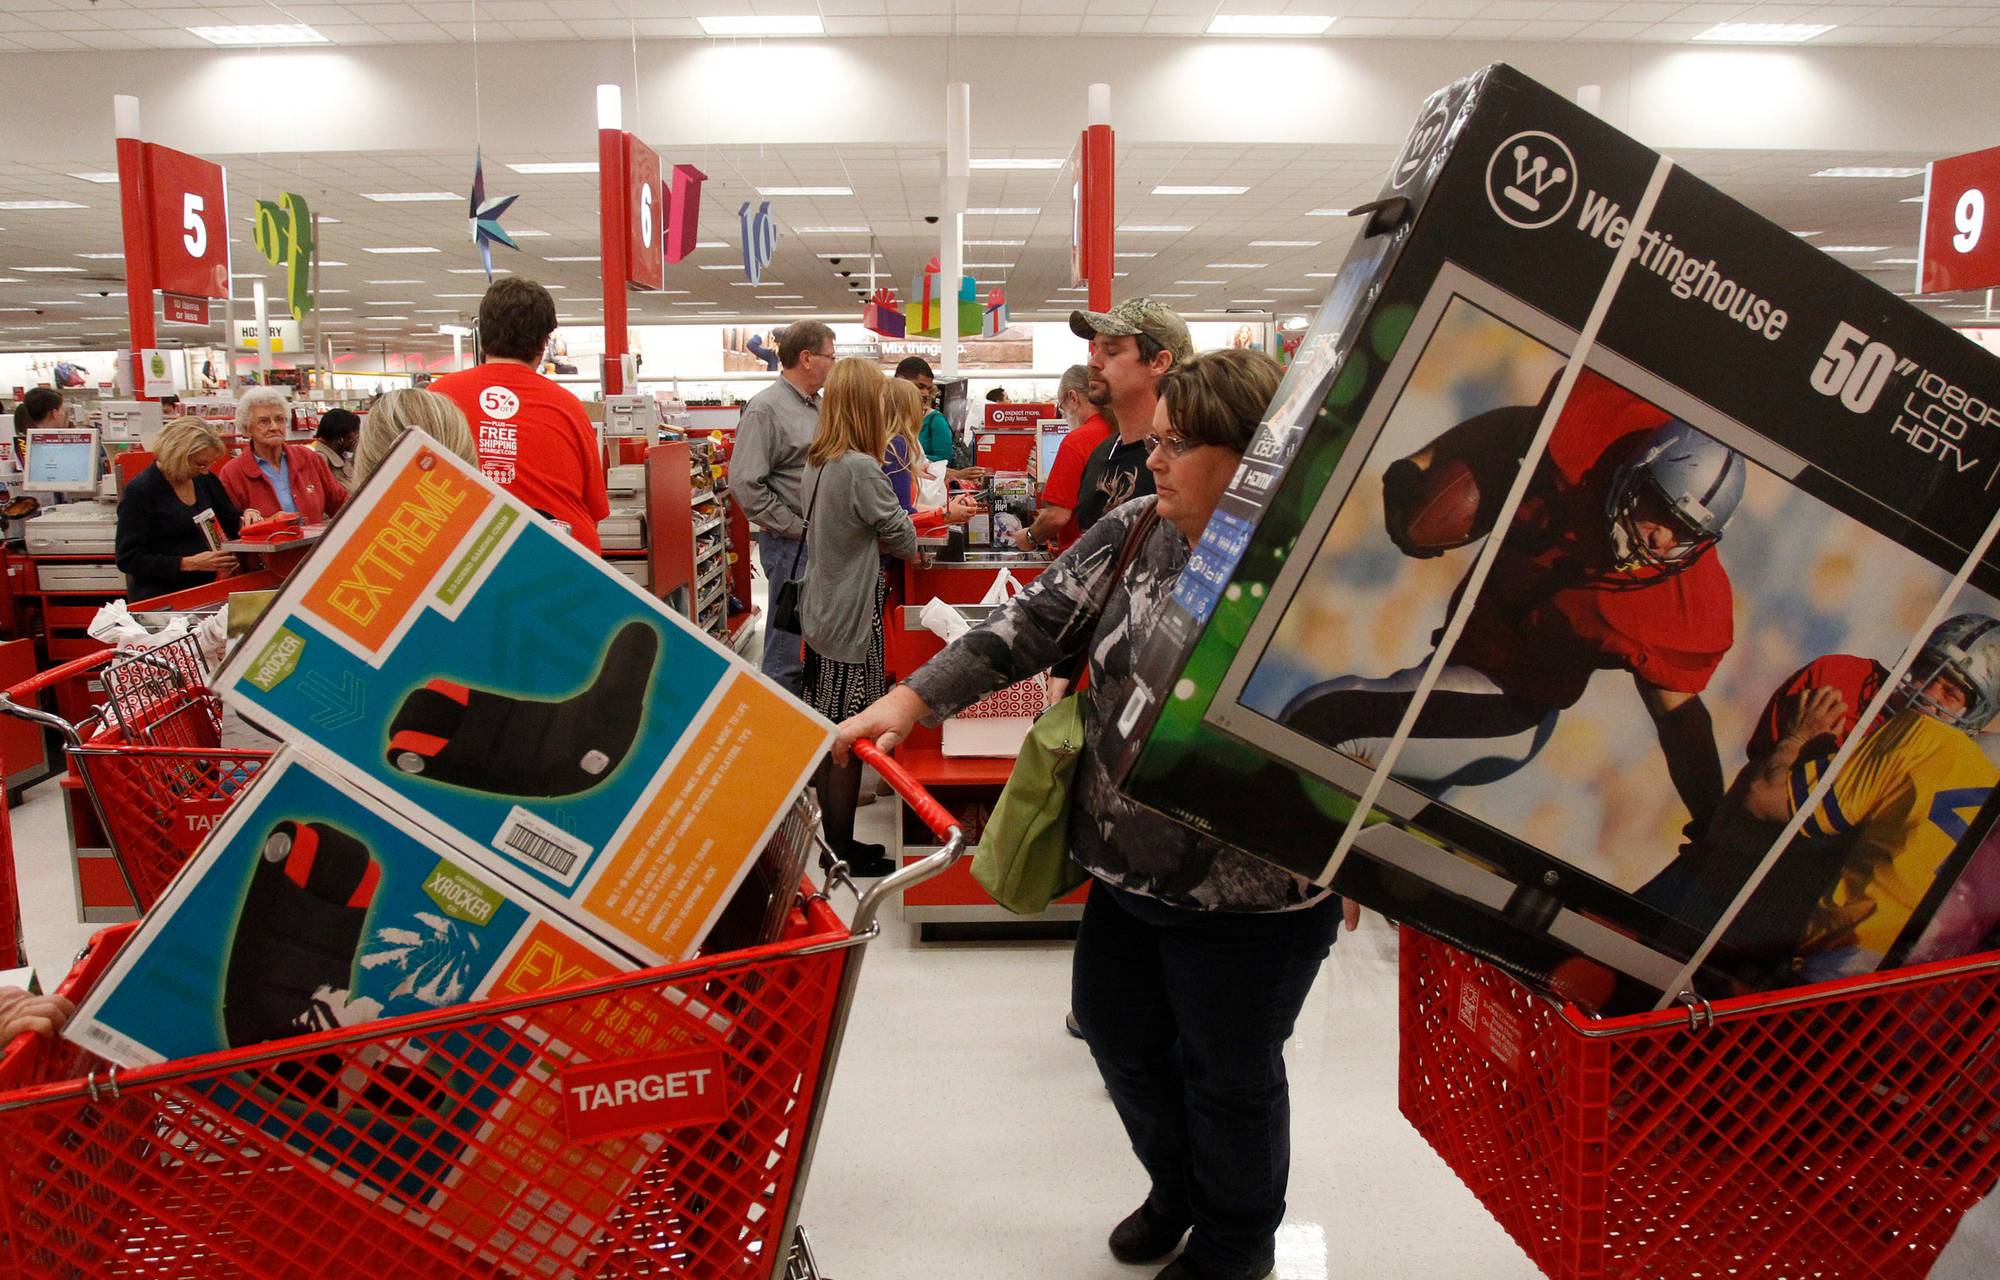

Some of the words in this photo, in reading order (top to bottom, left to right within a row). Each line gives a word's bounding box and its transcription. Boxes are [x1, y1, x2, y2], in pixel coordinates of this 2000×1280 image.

[184, 192, 207, 258] 5
[641, 183, 652, 248] 6
[1953, 188, 1984, 253] 9
[174, 299, 181, 308] 10
[182, 301, 200, 312] items
[184, 311, 198, 321] less
[242, 326, 282, 338] HORY
[882, 342, 905, 354] Mix
[485, 392, 515, 410] 5%
[1915, 369, 2000, 424] 1080P
[480, 426, 517, 441] FREE
[1905, 397, 1969, 441] LCD
[479, 438, 517, 450] SHIPPING
[1891, 415, 1981, 473] HDTV
[327, 471, 466, 627] EXTREME
[646, 815, 672, 848] SPEAKERS
[427, 871, 494, 920] XROCKER
[570, 1068, 712, 1112] TARGET
